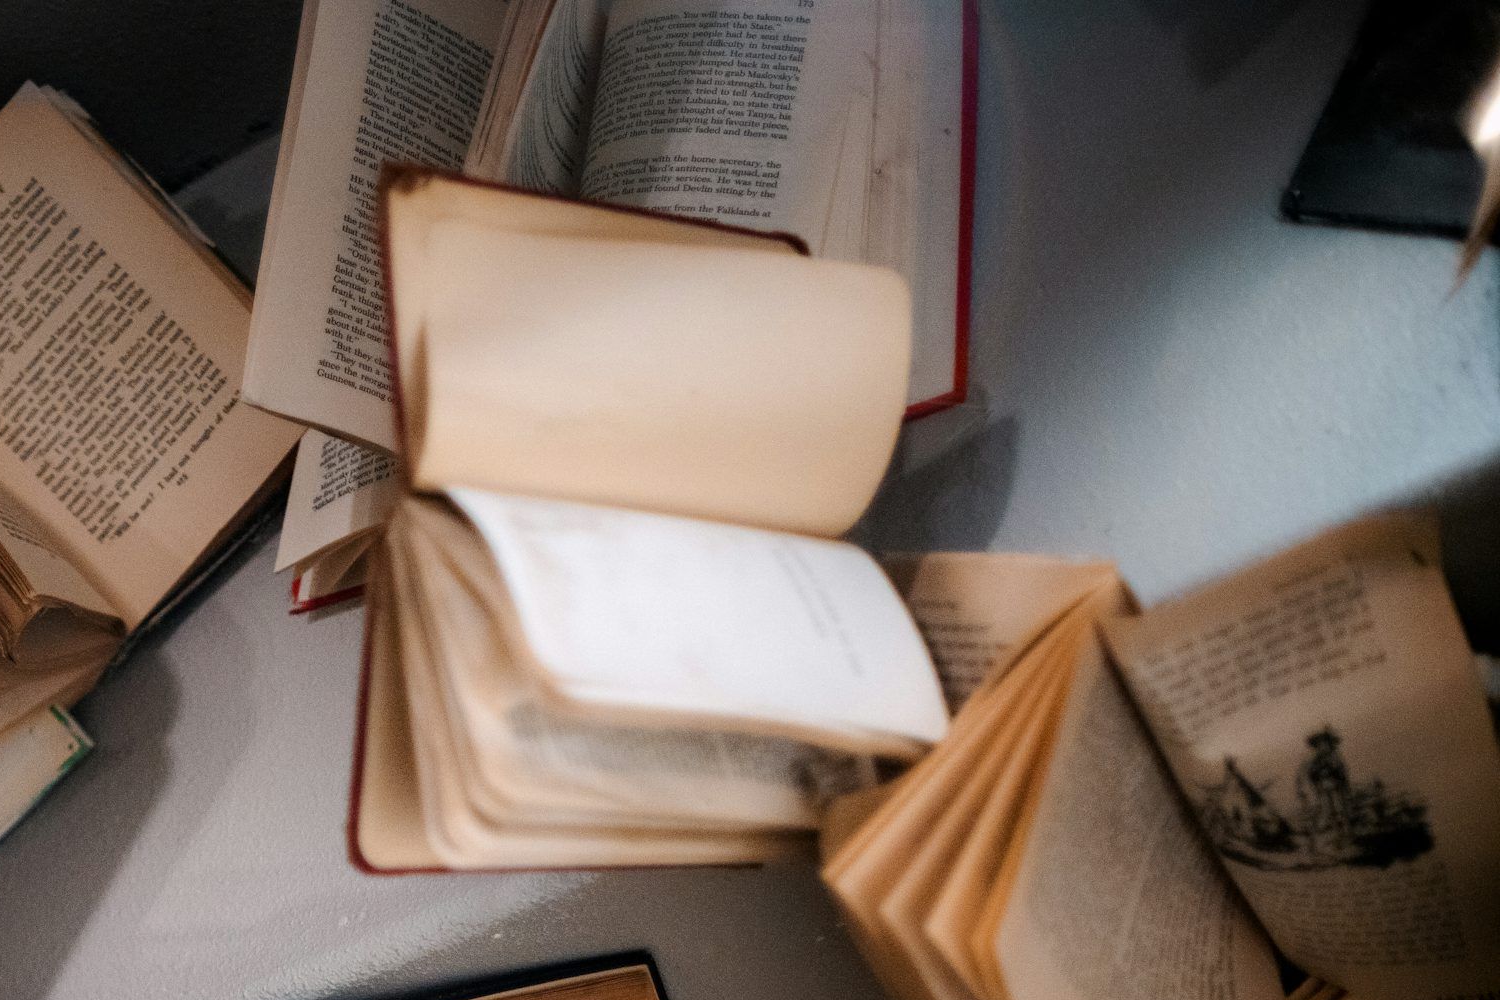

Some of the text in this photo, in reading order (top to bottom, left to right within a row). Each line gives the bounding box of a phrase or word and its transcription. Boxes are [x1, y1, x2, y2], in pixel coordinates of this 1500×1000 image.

[701, 11, 717, 19] will
[743, 12, 753, 20] be
[757, 13, 782, 21] taken
[784, 15, 794, 23] to
[796, 16, 811, 24] the
[374, 22, 391, 32] well
[668, 22, 696, 30] crimes
[699, 21, 729, 30] against
[665, 31, 689, 40] many
[693, 30, 722, 39] people
[746, 31, 757, 39] be
[783, 34, 807, 43] there
[371, 40, 414, 64] what I don't
[707, 40, 744, 49] difficulty
[749, 41, 757, 49] in
[762, 42, 805, 54] breathing
[370, 49, 396, 66] tapped
[688, 48, 701, 56] his
[730, 50, 744, 58] He
[745, 51, 776, 60] started
[789, 54, 803, 62] fall
[656, 58, 696, 68] Andropov
[699, 58, 733, 67] jumped
[678, 68, 711, 76] forward
[725, 69, 745, 78] grab
[769, 81, 797, 91] but he
[733, 88, 747, 97] tell
[750, 90, 795, 101] Andropov
[362, 97, 406, 122] doesn't add
[748, 100, 769, 108] state
[681, 107, 714, 115] thought
[360, 115, 403, 141] He listened
[370, 109, 423, 141] The red phone
[711, 116, 723, 124] his
[726, 117, 760, 127] favorite
[358, 126, 405, 152] phone down
[695, 126, 721, 134] faded
[723, 127, 741, 135] and
[743, 129, 767, 138] there
[770, 131, 787, 140] was
[652, 154, 671, 162] with
[674, 154, 688, 162] the
[691, 155, 716, 163] home
[766, 159, 781, 169] the
[675, 165, 729, 174] antiterrorist
[762, 170, 780, 178] and
[717, 176, 730, 184] He
[735, 178, 751, 186] was
[755, 178, 778, 188] tired
[683, 185, 713, 193] Devlin
[715, 186, 744, 197] sitting
[746, 188, 758, 197] by
[760, 190, 775, 198] the
[343, 214, 357, 225] the
[342, 225, 358, 236] that
[337, 254, 379, 277] loose over
[333, 275, 366, 294] German
[325, 328, 343, 339] with
[326, 317, 381, 343] about this one
[318, 359, 358, 377] since the
[359, 385, 386, 401] among
